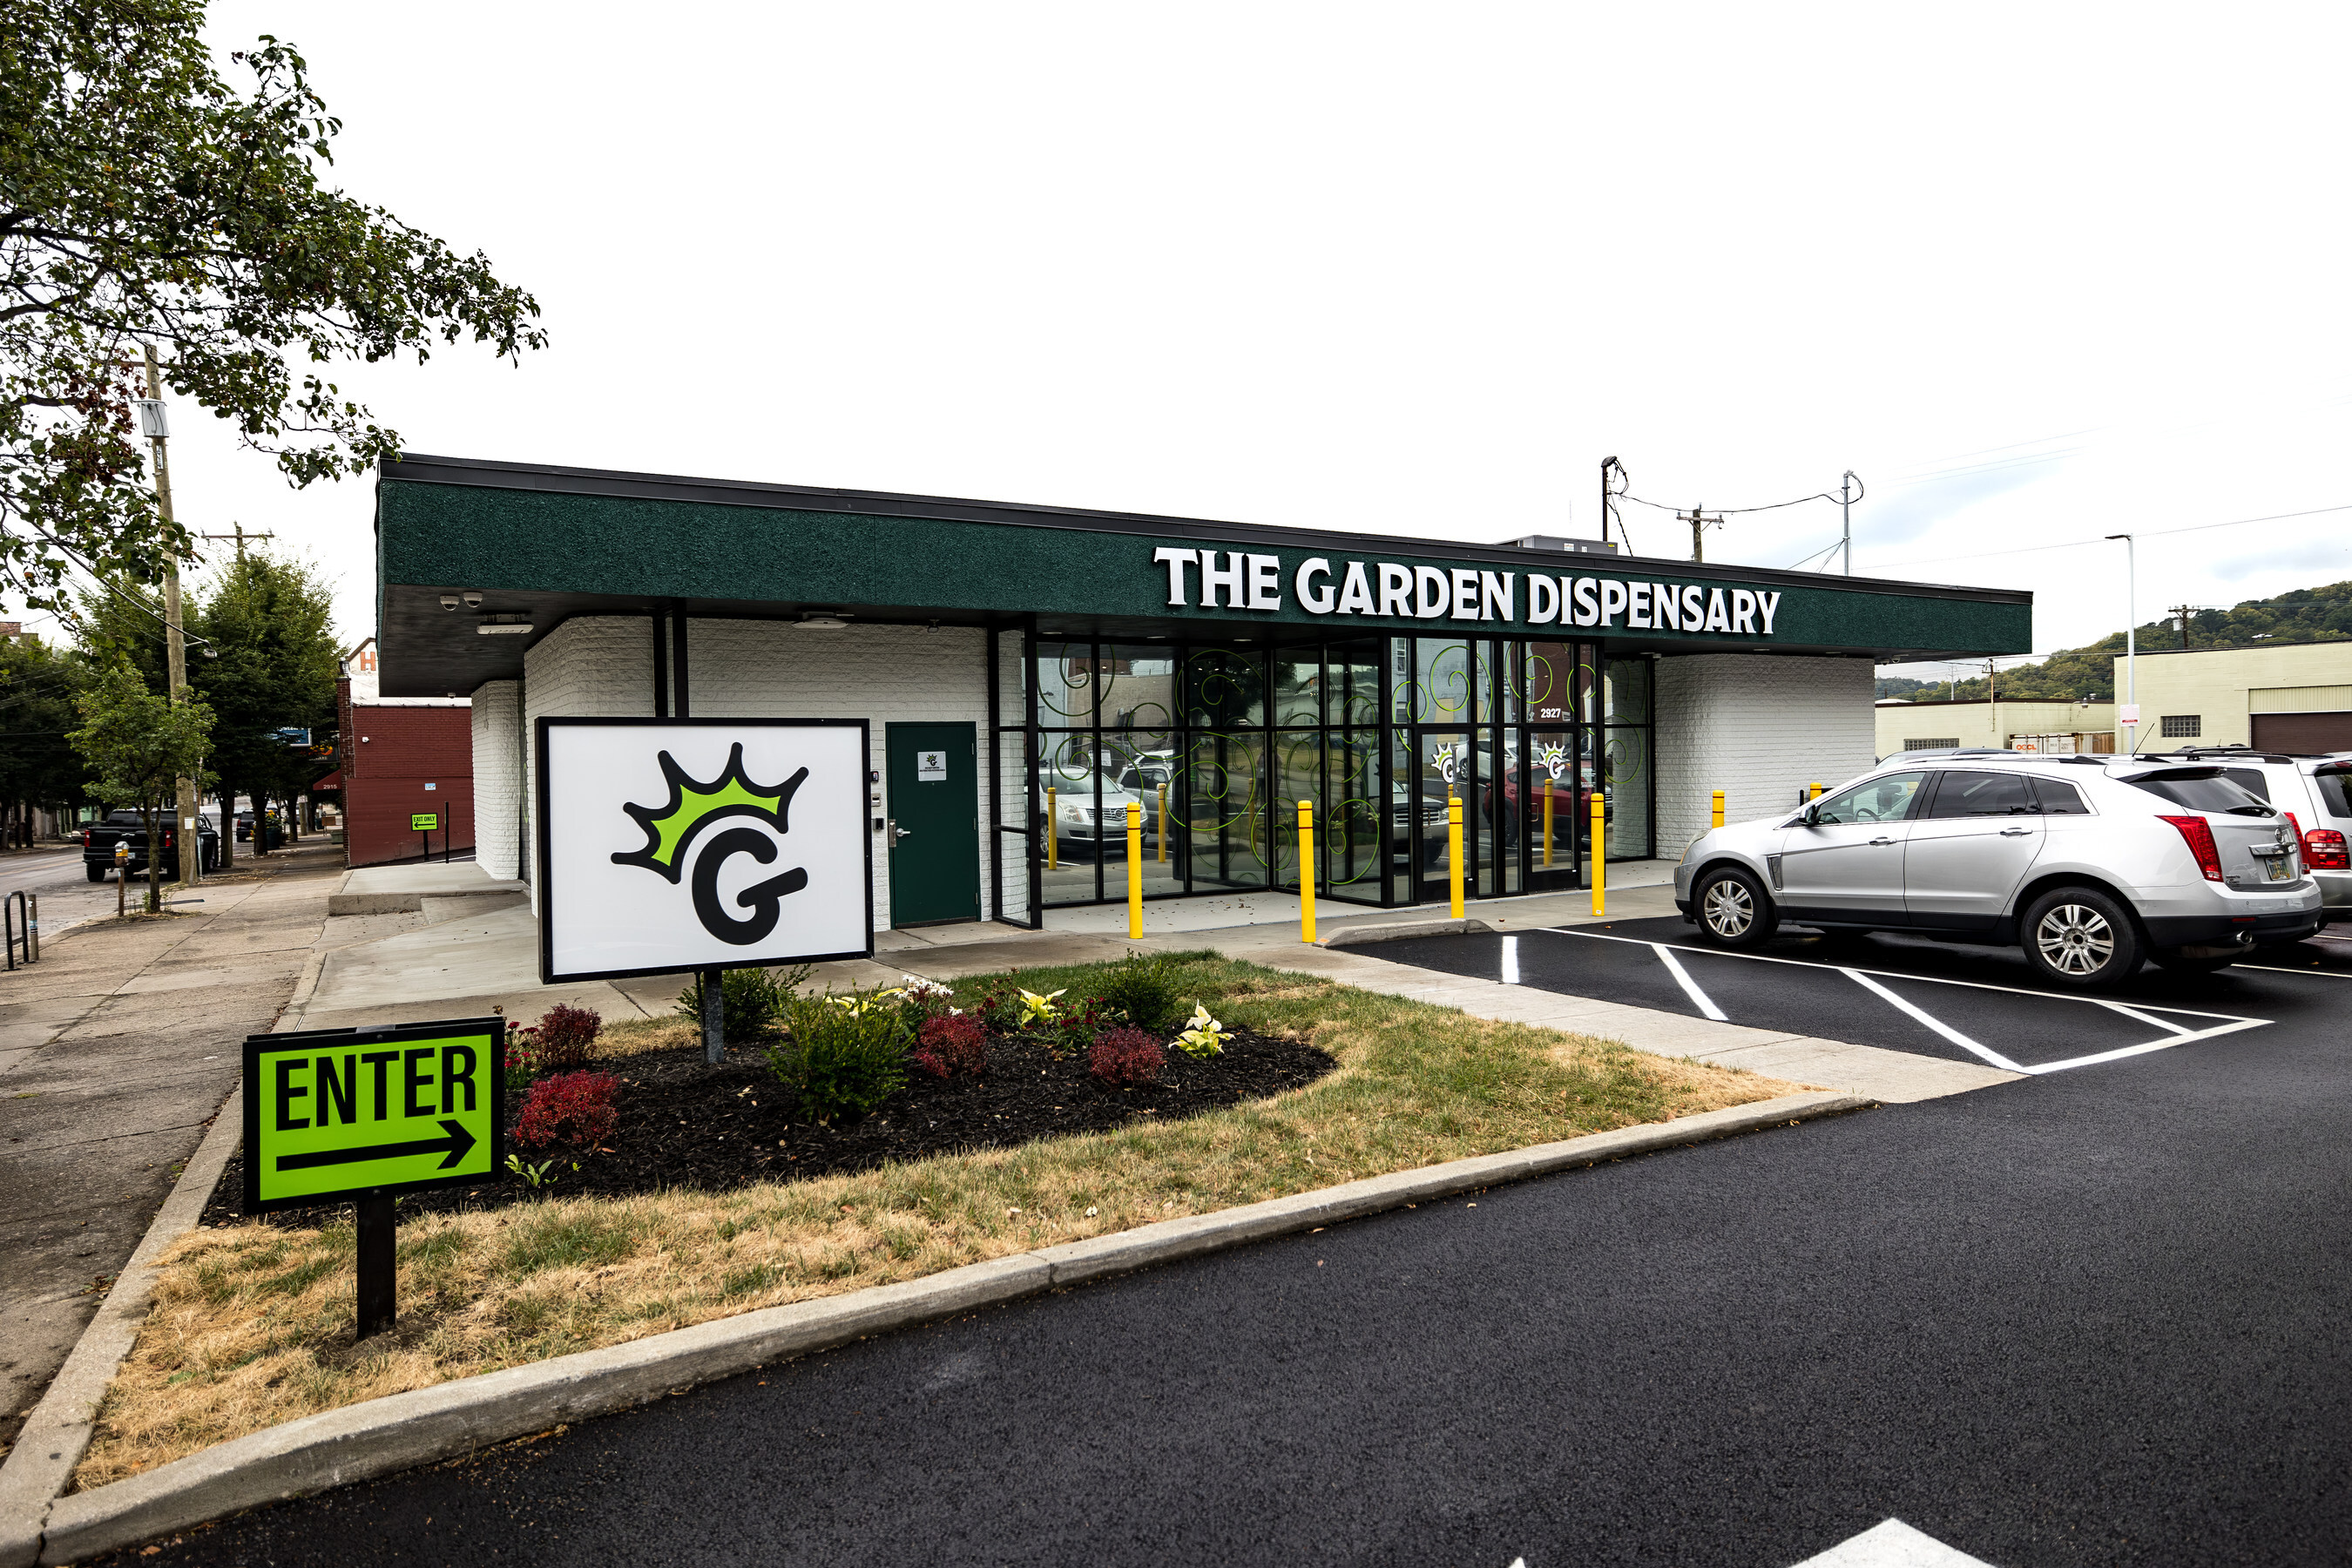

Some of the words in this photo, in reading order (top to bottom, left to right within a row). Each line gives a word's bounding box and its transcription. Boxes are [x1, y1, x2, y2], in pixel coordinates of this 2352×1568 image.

[1153, 546, 1282, 611] THE
[1295, 557, 1516, 622] GARDEN
[1527, 573, 1781, 634] DISPENSARY
[1540, 707, 1562, 719] 2927
[691, 827, 809, 946] G
[275, 1044, 477, 1132] ENTER
